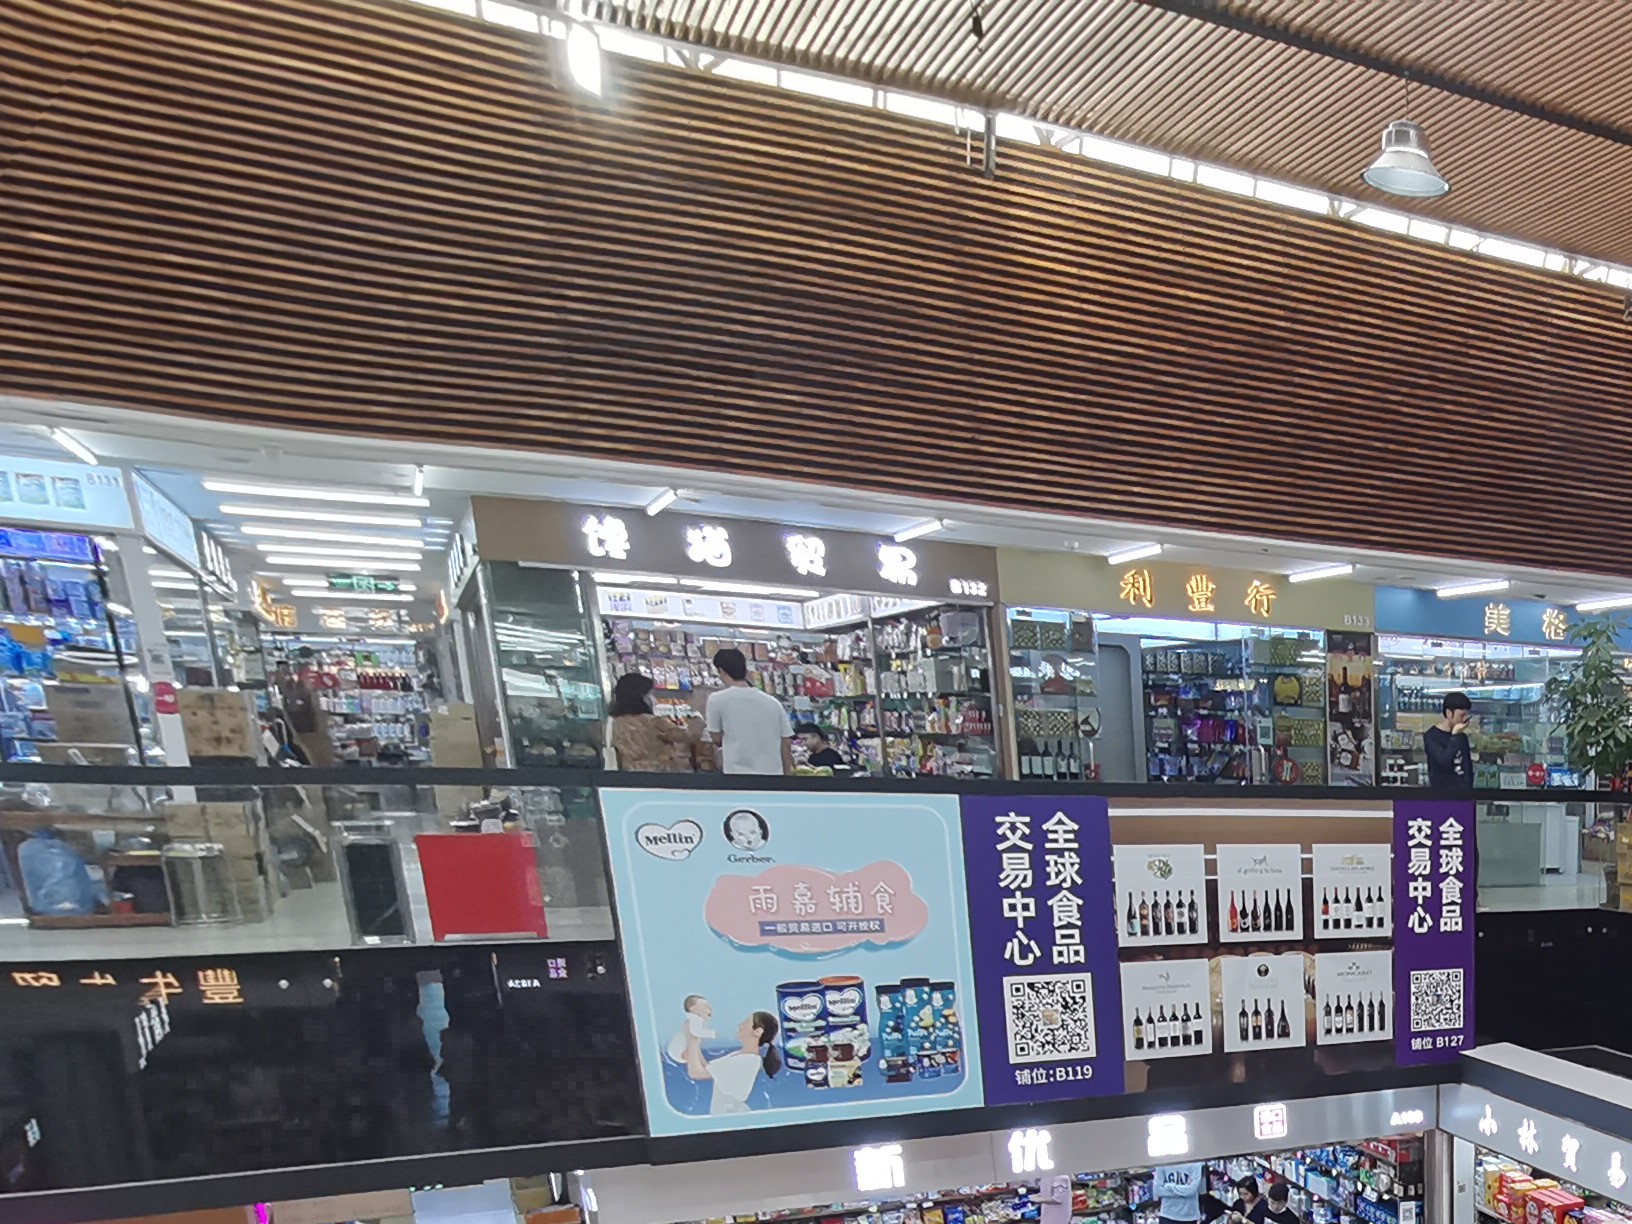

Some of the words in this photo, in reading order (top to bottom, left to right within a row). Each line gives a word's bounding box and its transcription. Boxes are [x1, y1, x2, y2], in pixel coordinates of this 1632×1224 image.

[1119, 568, 1278, 618] 利豐行
[1343, 614, 1370, 627] B133
[644, 832, 696, 847] Mellin
[748, 881, 895, 916] 雨嘉辅食
[994, 812, 1042, 967] 交易中心
[1042, 811, 1086, 965] 全球食品
[1406, 818, 1433, 934] 交易中心
[1438, 817, 1465, 933] 全球食品
[1411, 1035, 1434, 1052] 铺位
[1436, 1034, 1465, 1049] B127
[854, 1113, 1190, 1192] 新优品
